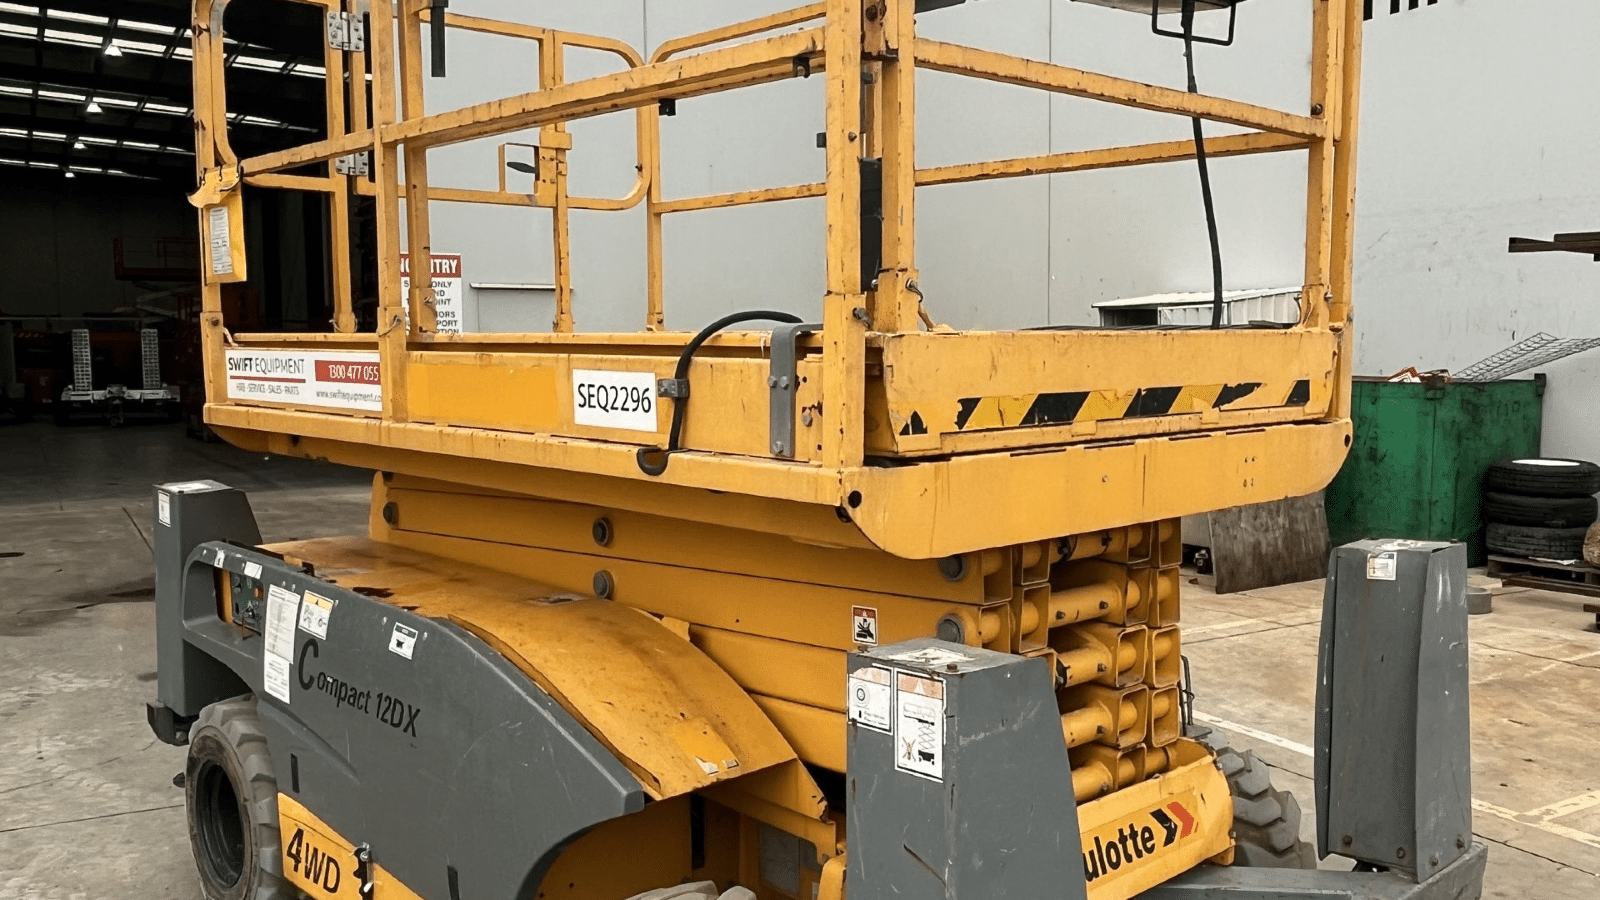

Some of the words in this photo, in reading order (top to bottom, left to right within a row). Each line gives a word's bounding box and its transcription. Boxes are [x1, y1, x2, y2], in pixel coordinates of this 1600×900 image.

[431, 258, 458, 273] TRY
[435, 298, 451, 306] INT
[228, 357, 253, 372] SWIFT
[255, 357, 305, 375] EQUIPMENT
[328, 364, 346, 379] 1300
[346, 365, 362, 380] 477
[363, 365, 379, 382] 055
[577, 382, 652, 414] SEQ2296
[298, 638, 371, 715] Compact
[376, 692, 421, 738] 12DX
[286, 827, 341, 894] 4WD
[1082, 823, 1156, 882] ulotte
